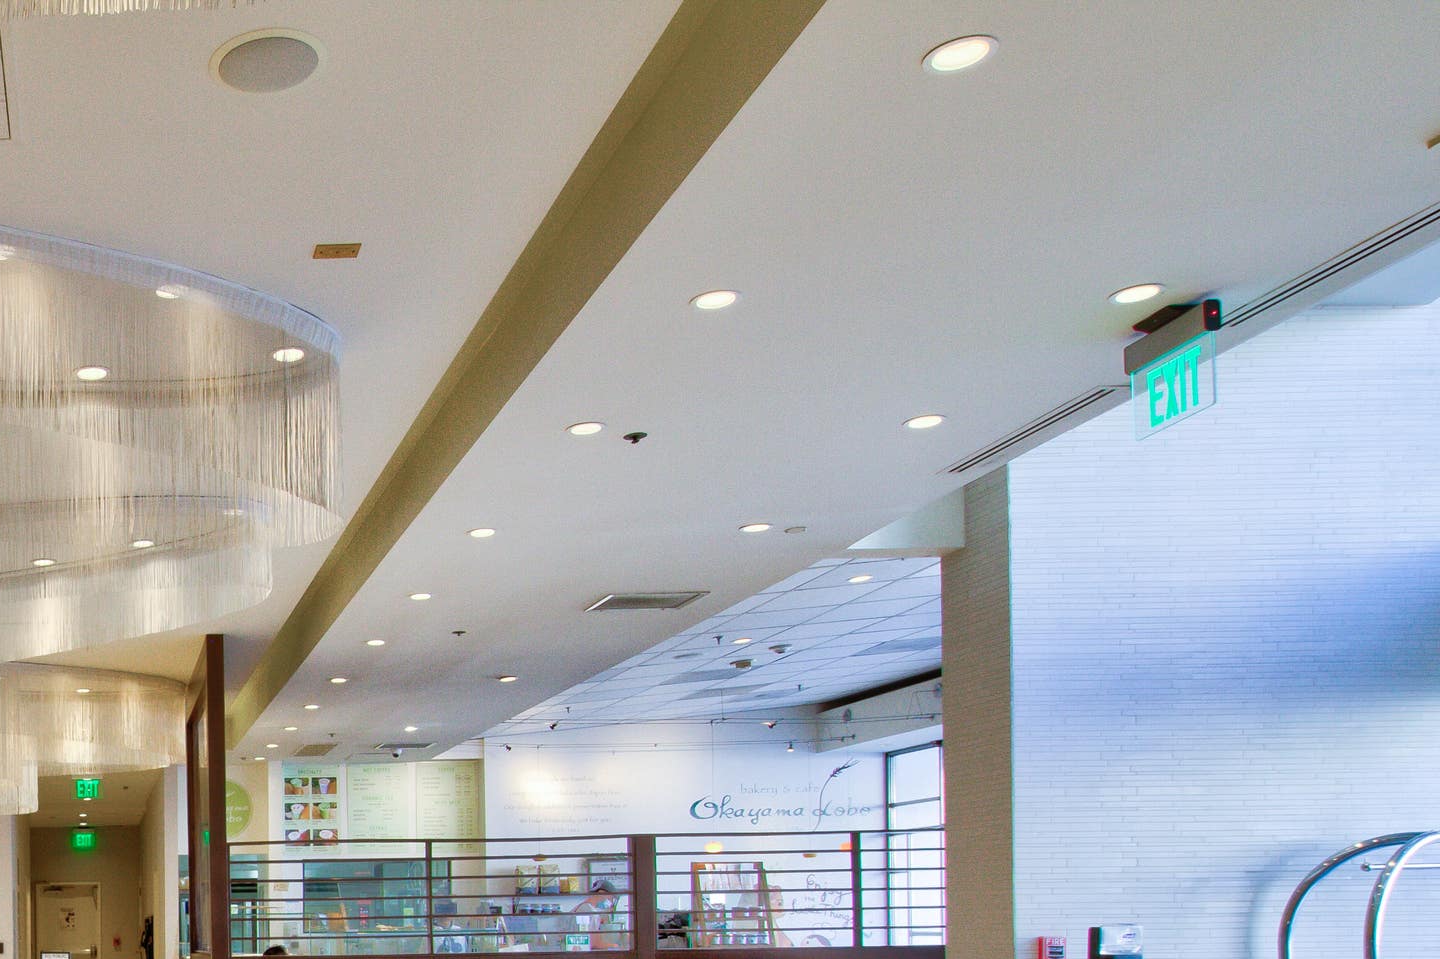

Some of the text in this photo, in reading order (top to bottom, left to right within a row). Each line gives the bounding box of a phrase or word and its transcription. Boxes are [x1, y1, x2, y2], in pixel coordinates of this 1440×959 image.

[1146, 345, 1201, 428] EXIT
[76, 780, 99, 798] EXIT
[739, 783, 778, 795] bakery
[689, 793, 805, 825] Okayama
[76, 834, 92, 847] EXIT
[1045, 937, 1065, 946] FIRE
